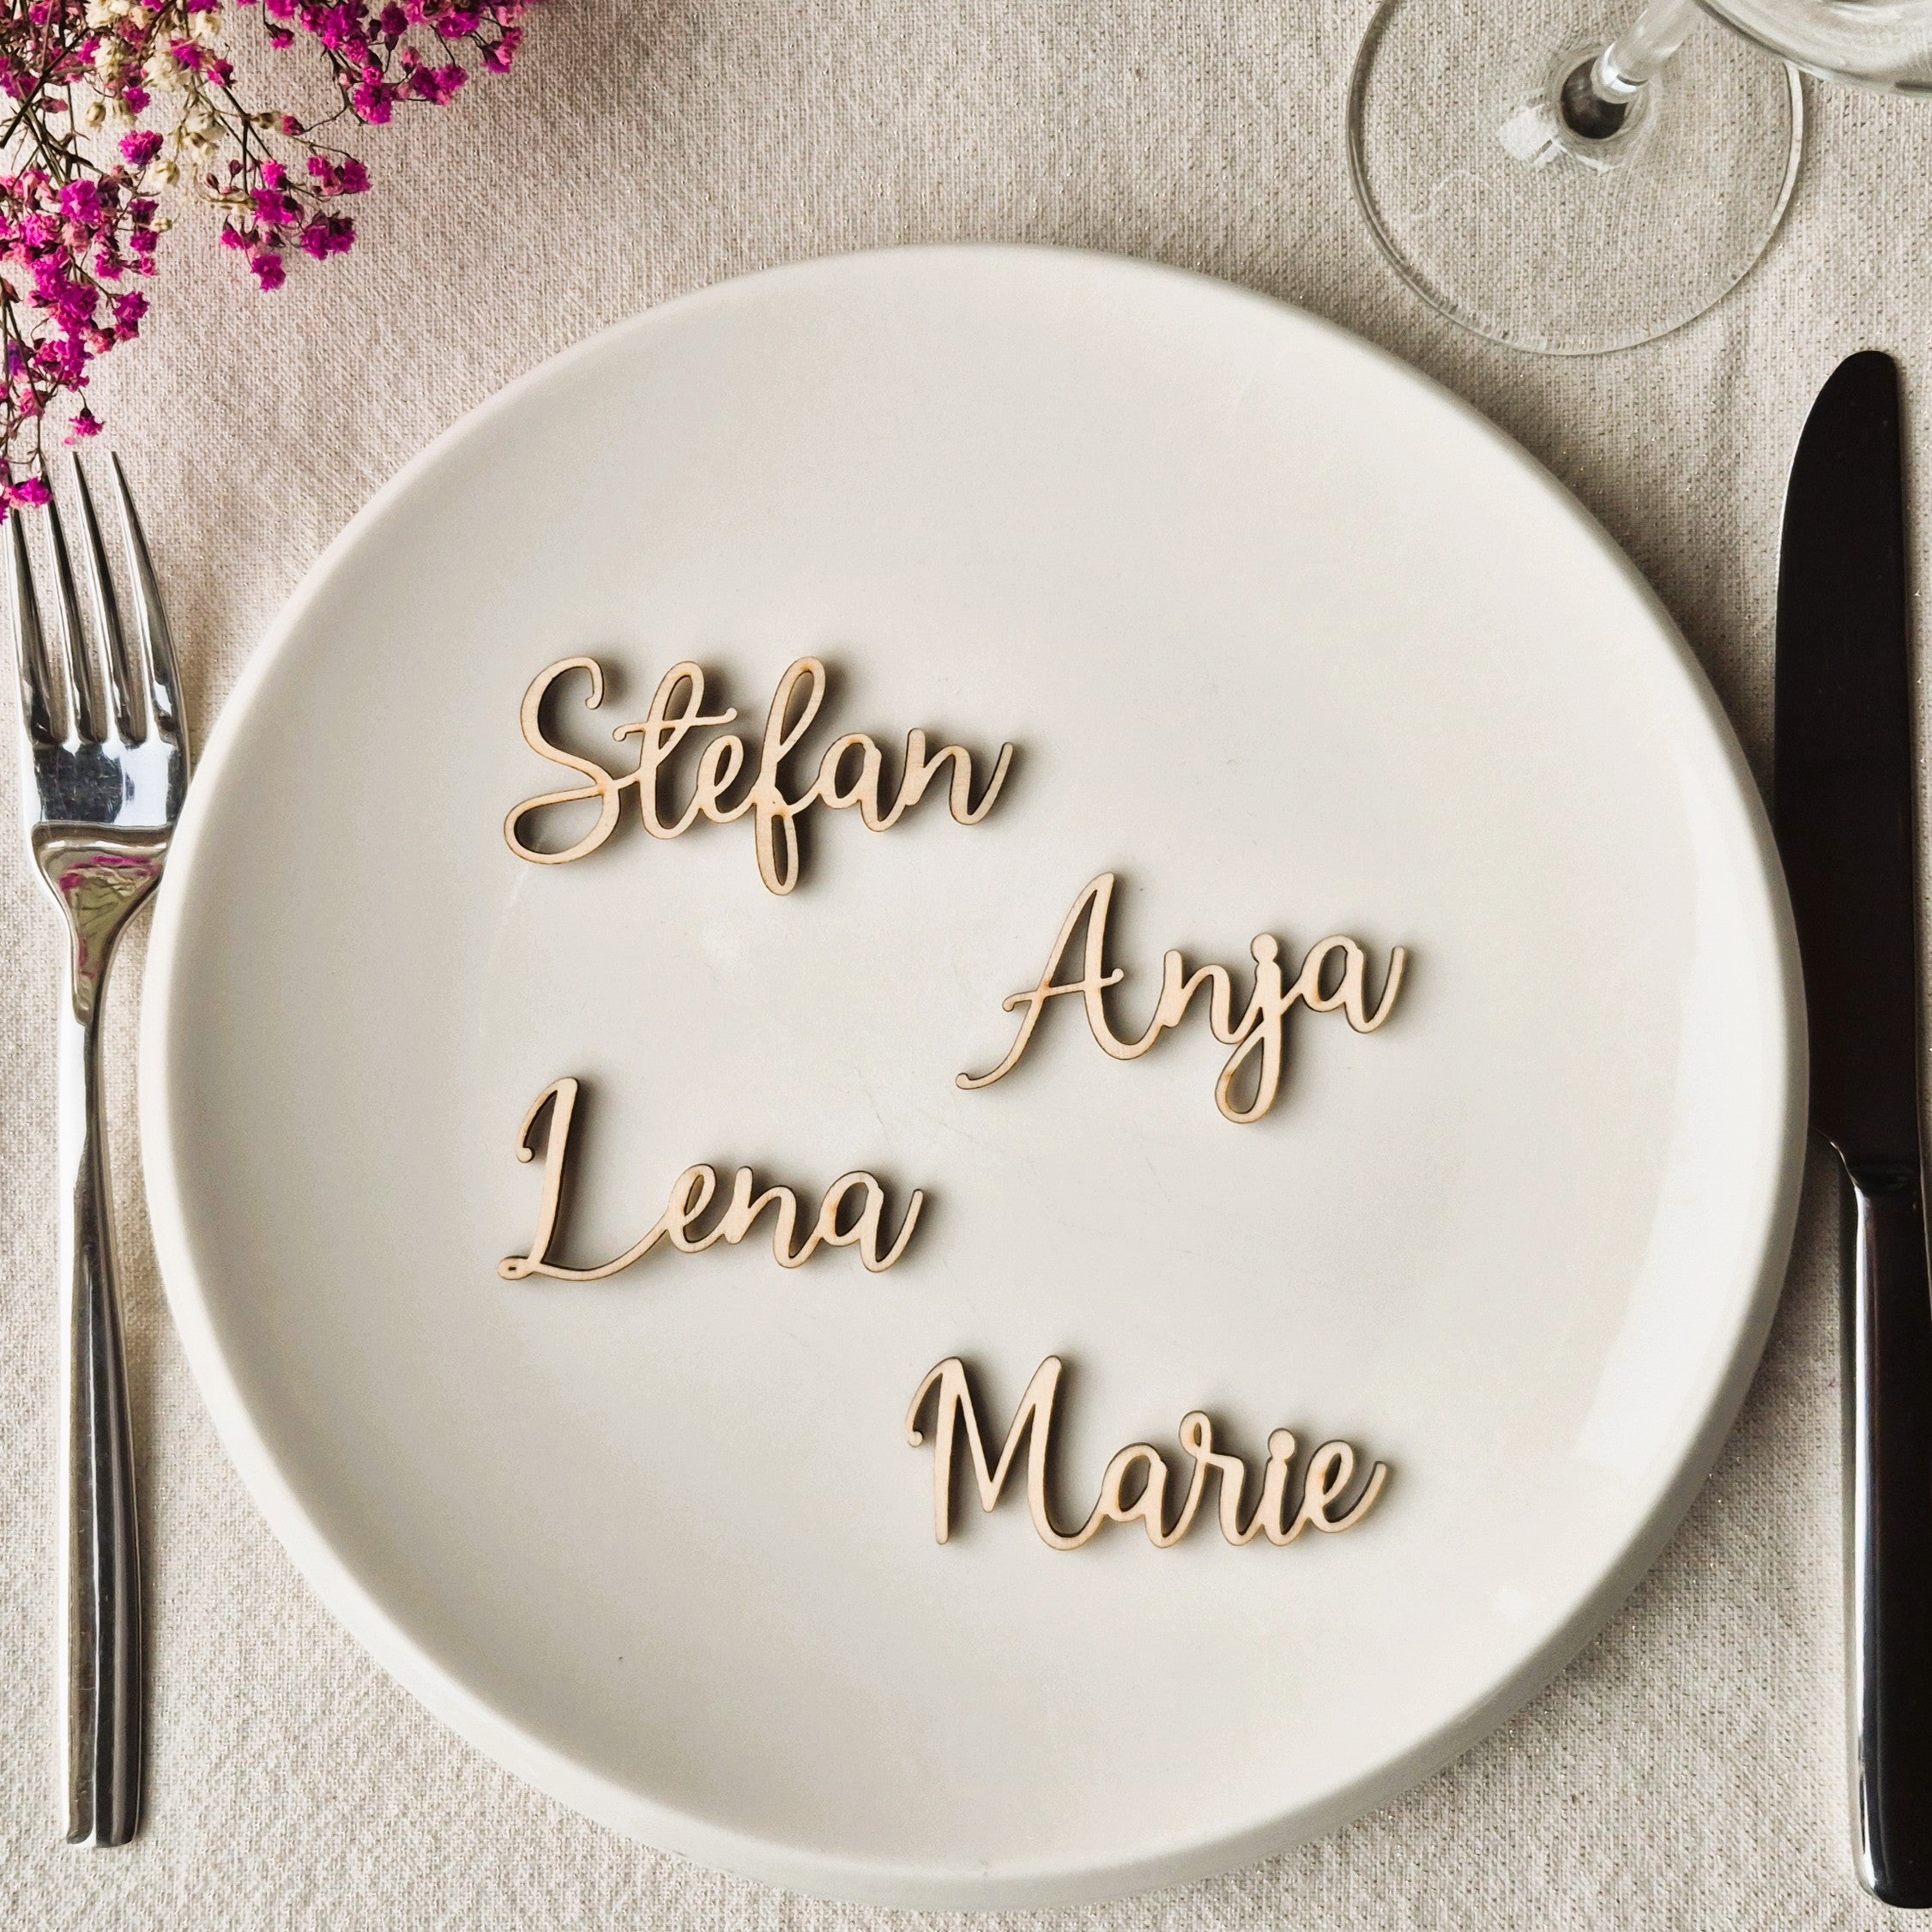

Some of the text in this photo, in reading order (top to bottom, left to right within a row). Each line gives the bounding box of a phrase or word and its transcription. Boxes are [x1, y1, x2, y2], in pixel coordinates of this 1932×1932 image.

[504, 656, 1014, 896] Stefan
[955, 872, 1407, 1124] Anja
[498, 1078, 924, 1281] Lena
[907, 1355, 1388, 1550] Marie
